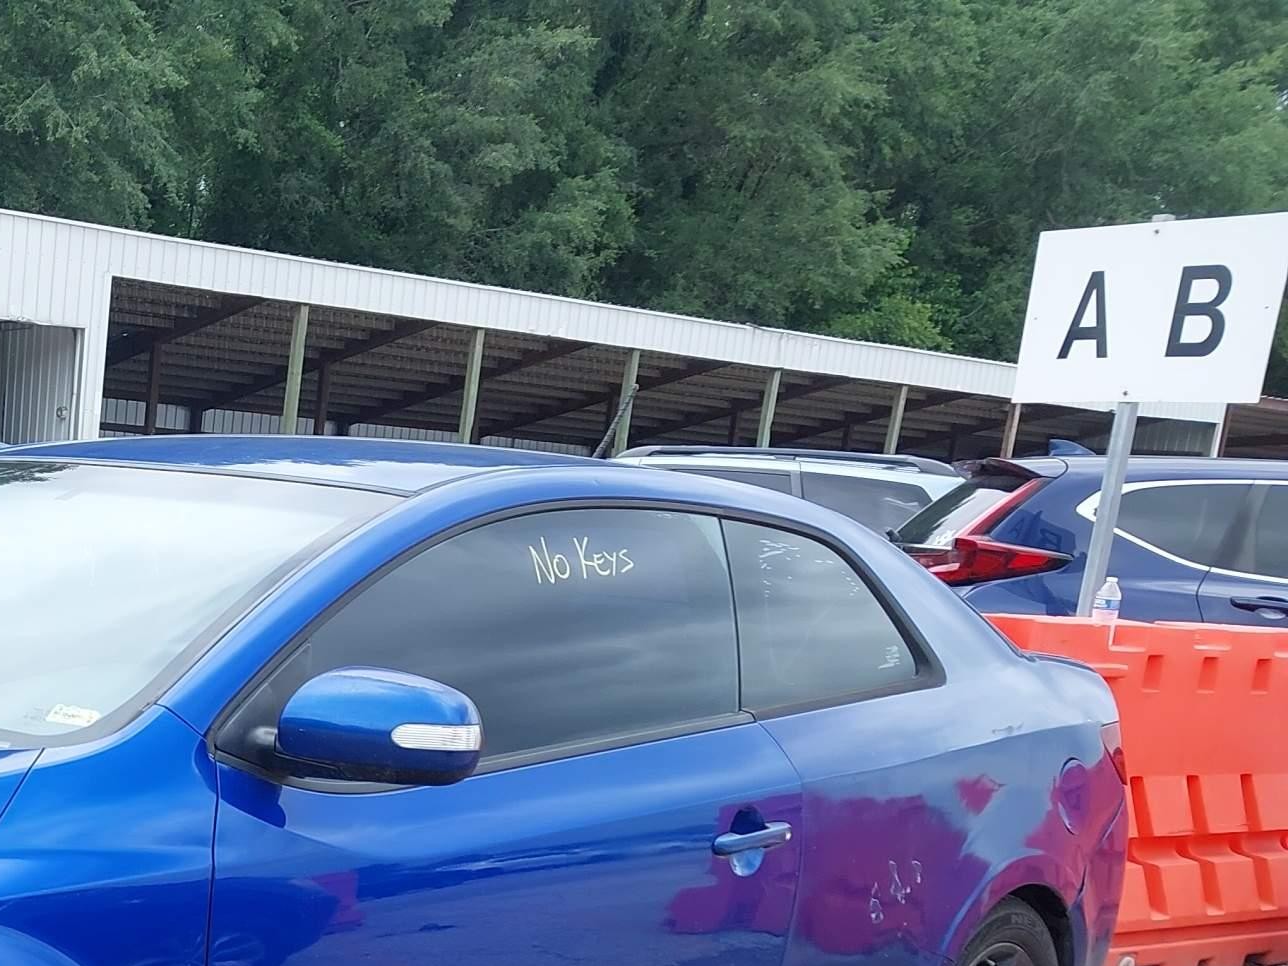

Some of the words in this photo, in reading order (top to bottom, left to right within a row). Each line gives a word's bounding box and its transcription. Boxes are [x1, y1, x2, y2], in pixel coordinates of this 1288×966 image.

[1056, 271, 1108, 360] A
[1165, 264, 1233, 357] B
[528, 536, 570, 584] No
